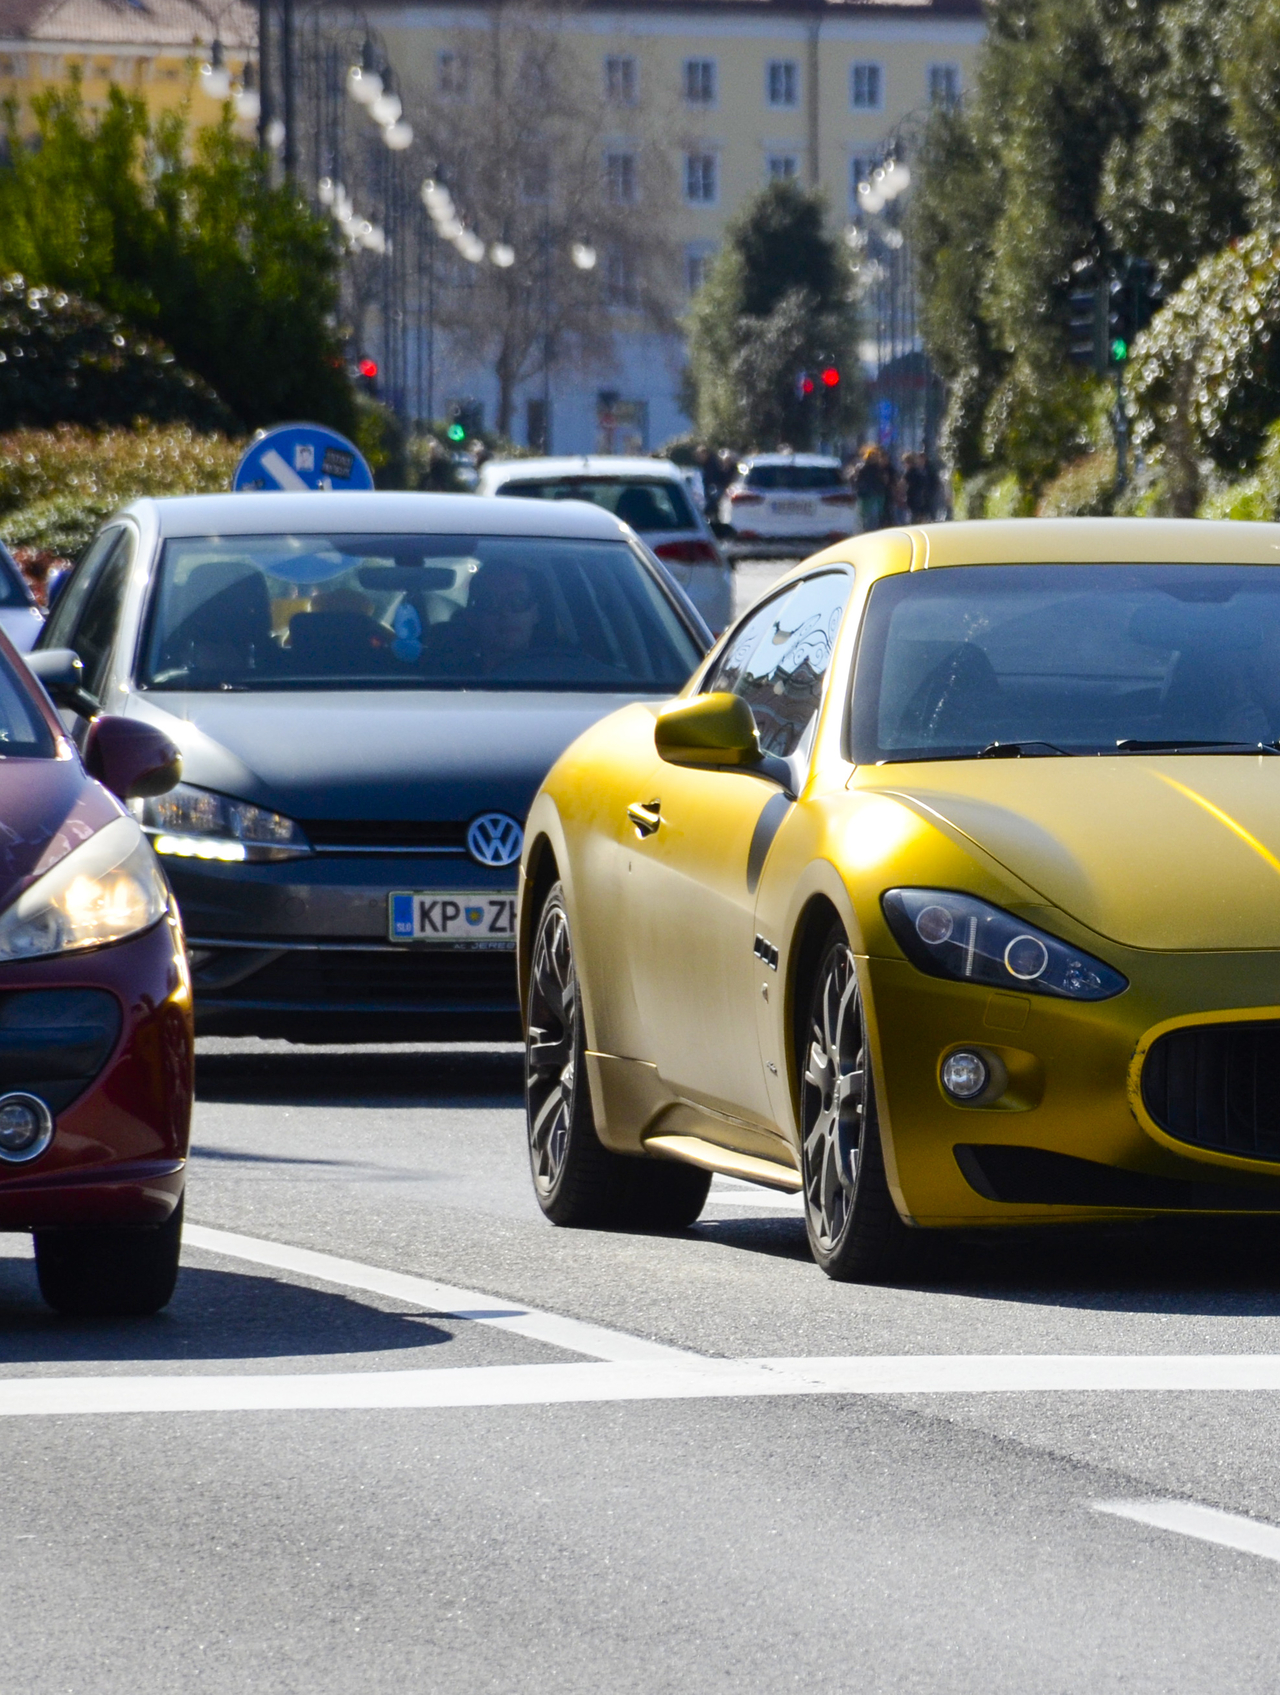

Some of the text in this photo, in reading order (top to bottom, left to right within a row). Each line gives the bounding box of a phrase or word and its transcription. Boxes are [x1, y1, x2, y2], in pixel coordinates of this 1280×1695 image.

[470, 815, 522, 864] VW
[396, 922, 412, 933] SLO
[419, 900, 461, 932] KP
